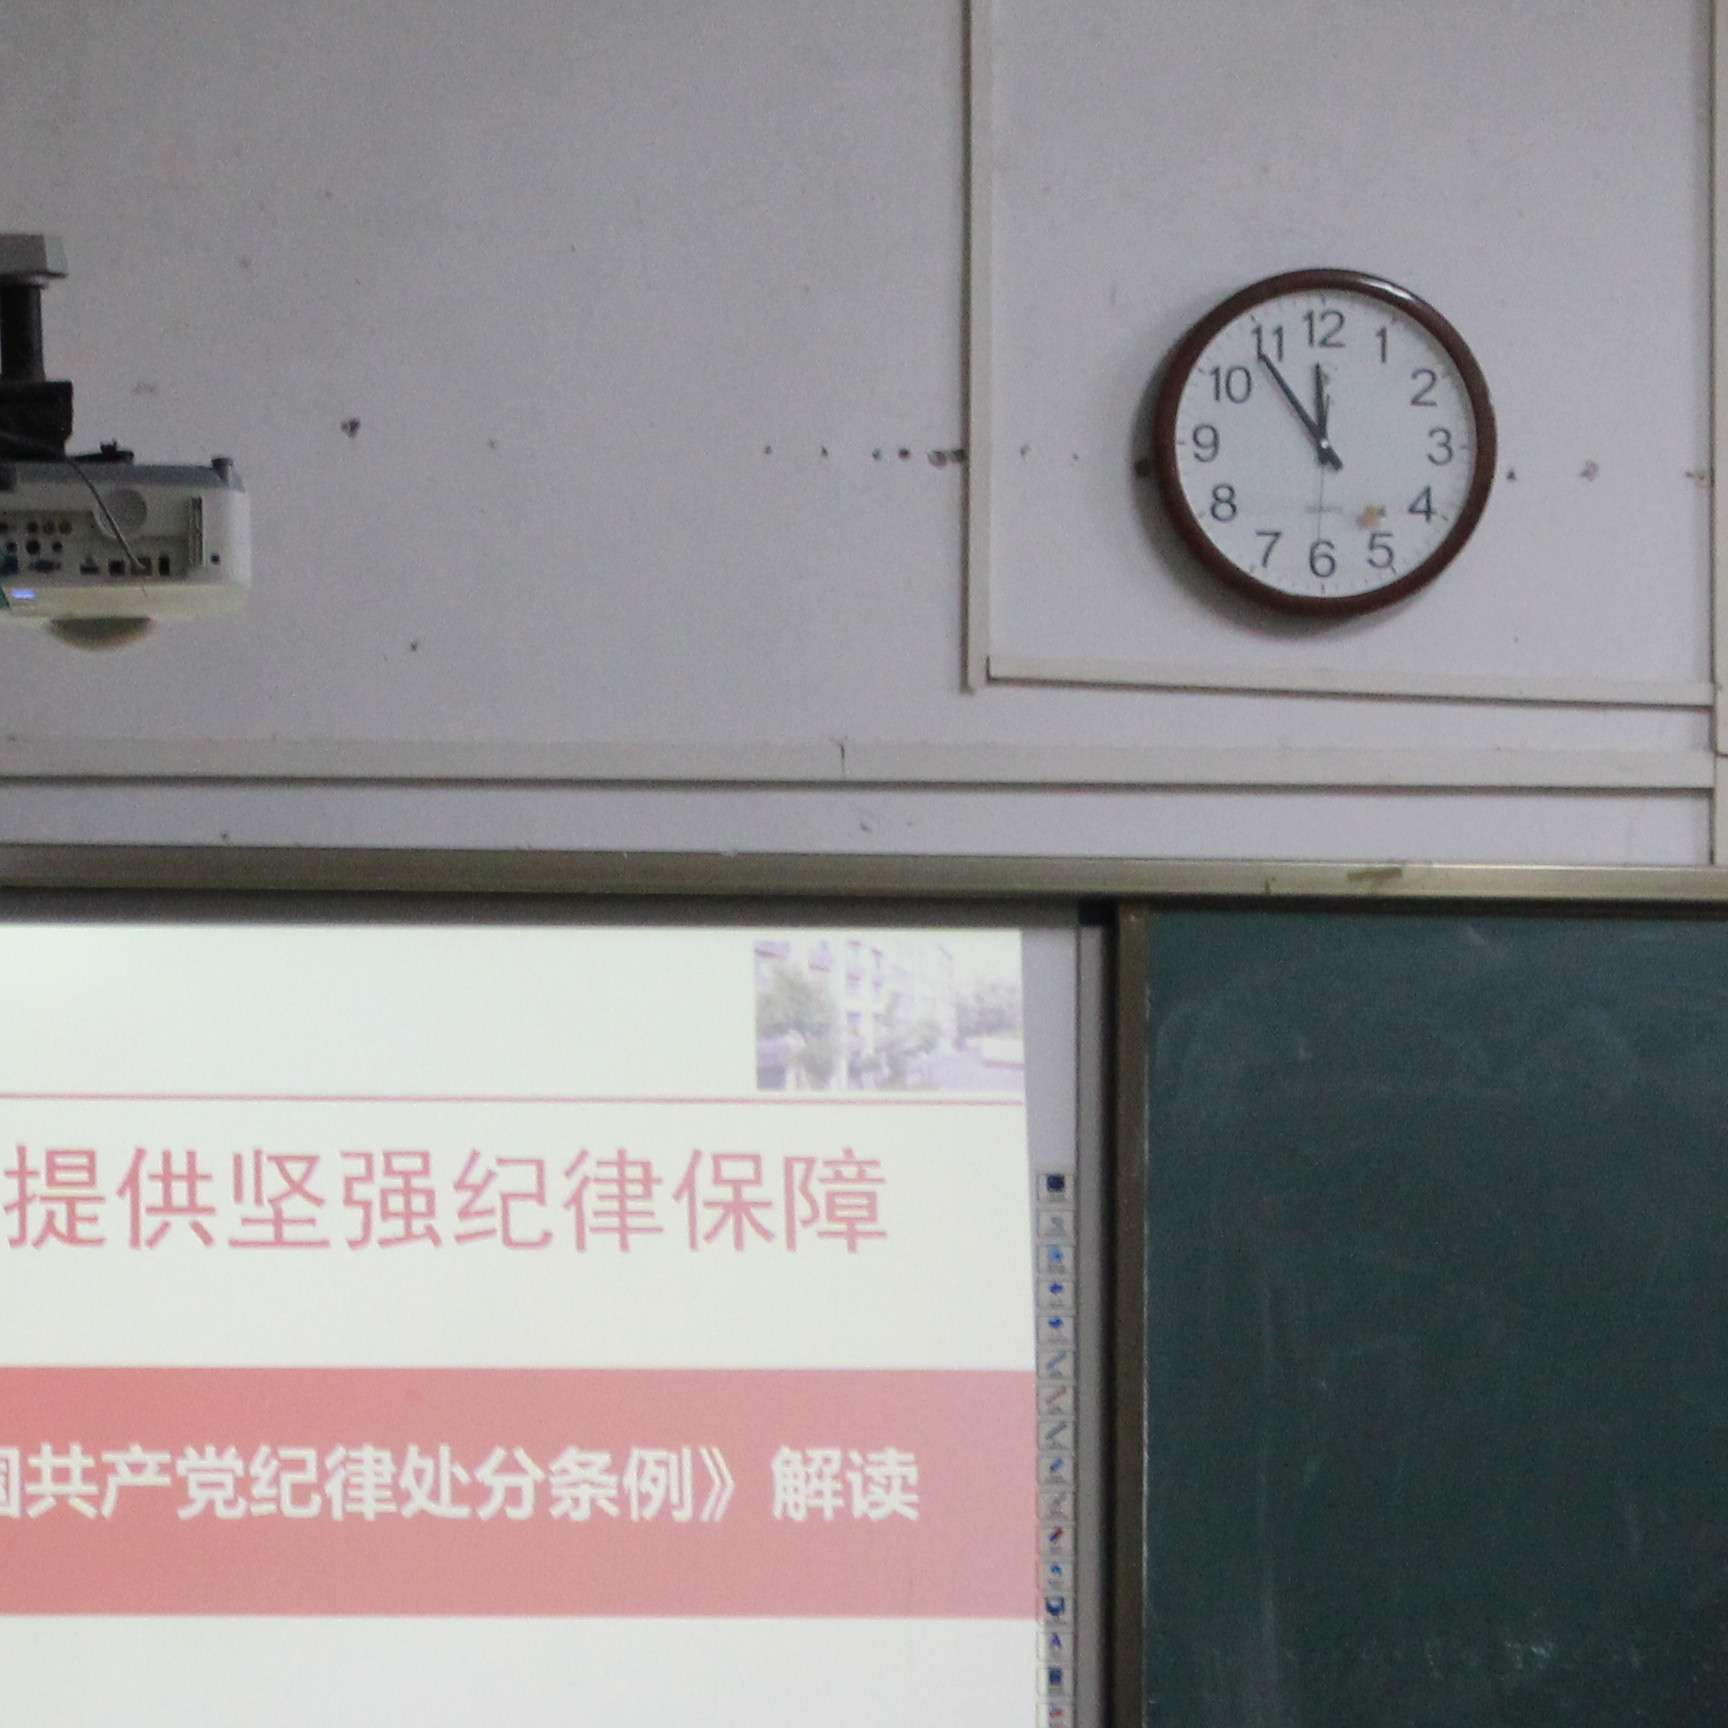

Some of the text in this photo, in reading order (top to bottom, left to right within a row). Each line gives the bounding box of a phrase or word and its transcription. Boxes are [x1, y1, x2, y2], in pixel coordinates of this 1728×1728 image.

[1252, 325, 1284, 362] 11
[1303, 310, 1346, 348] 12
[1376, 326, 1387, 363] 1
[1210, 366, 1252, 403] 10
[1410, 369, 1438, 407] 2
[1192, 424, 1220, 462] 9
[1427, 427, 1454, 466] 3
[1210, 484, 1238, 521] 8
[1407, 486, 1435, 522] 4
[1256, 531, 1282, 568] 7
[1309, 540, 1336, 577] 6
[1367, 532, 1394, 568] 5
